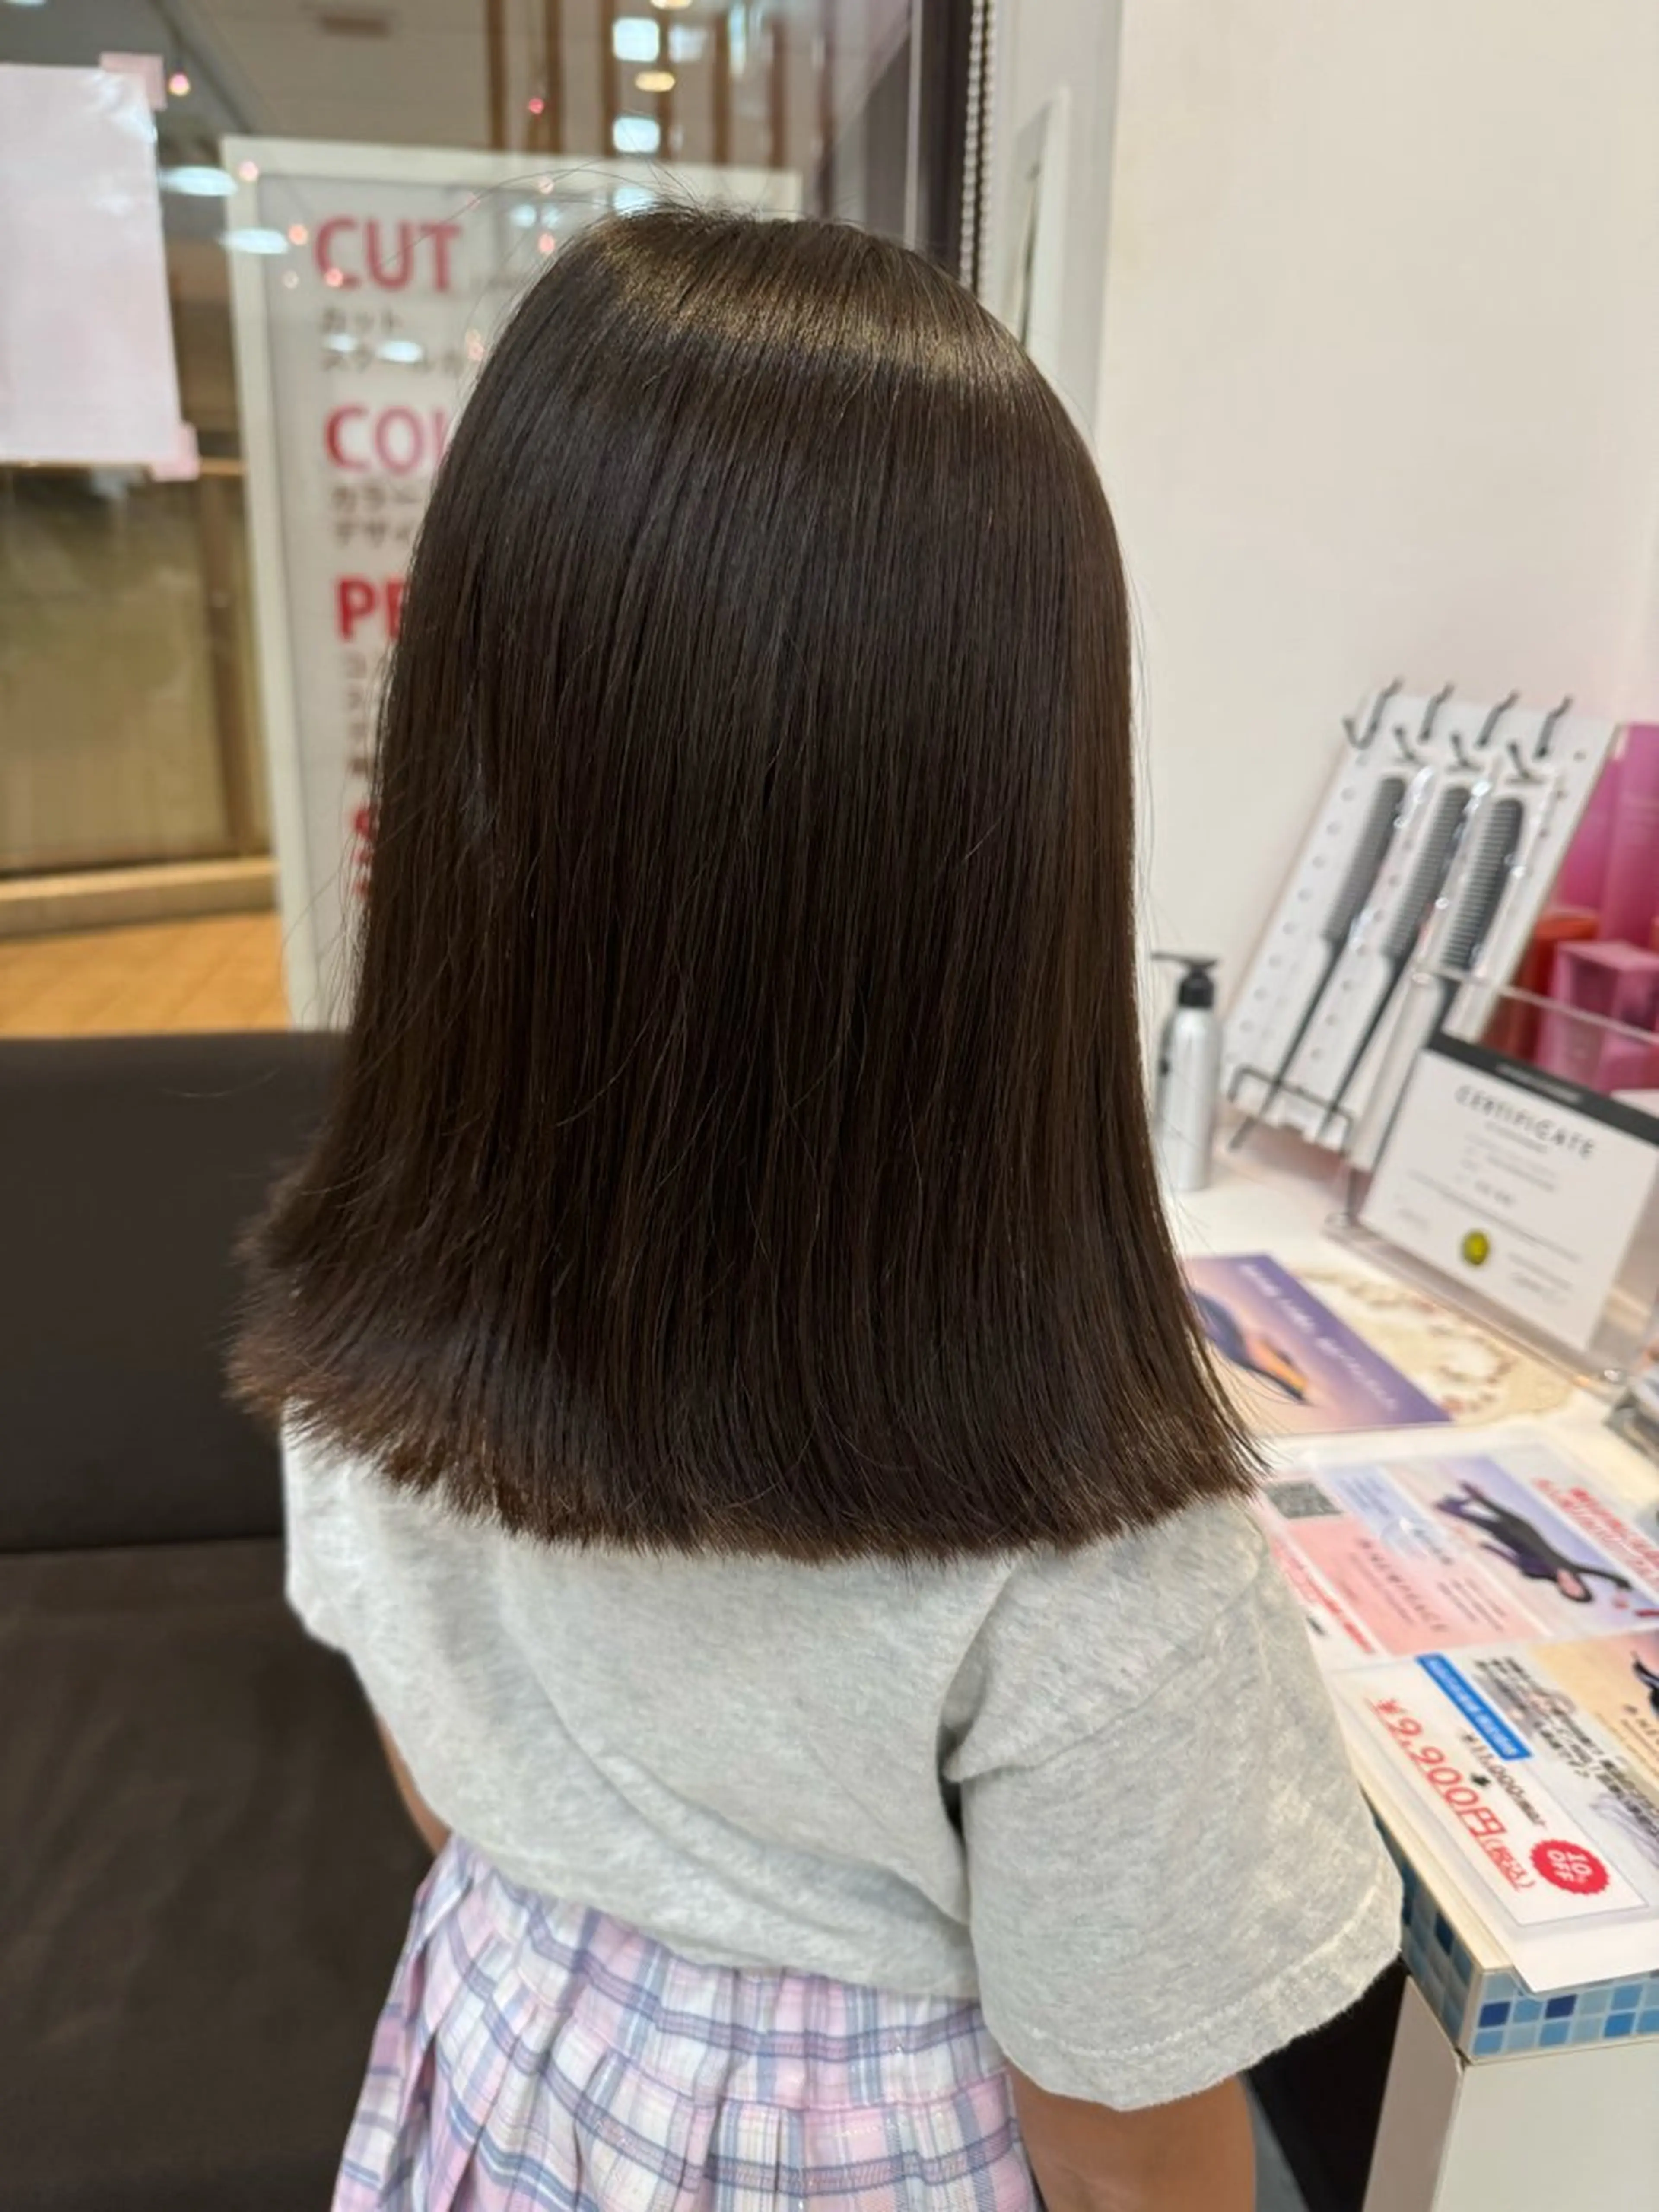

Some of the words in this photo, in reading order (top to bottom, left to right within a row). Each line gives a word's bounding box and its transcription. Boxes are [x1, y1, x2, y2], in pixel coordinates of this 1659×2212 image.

[315, 216, 462, 292] CUT
[1454, 1084, 1594, 1159] CERTIFICATE
[1547, 1849, 1574, 1882] OFF
